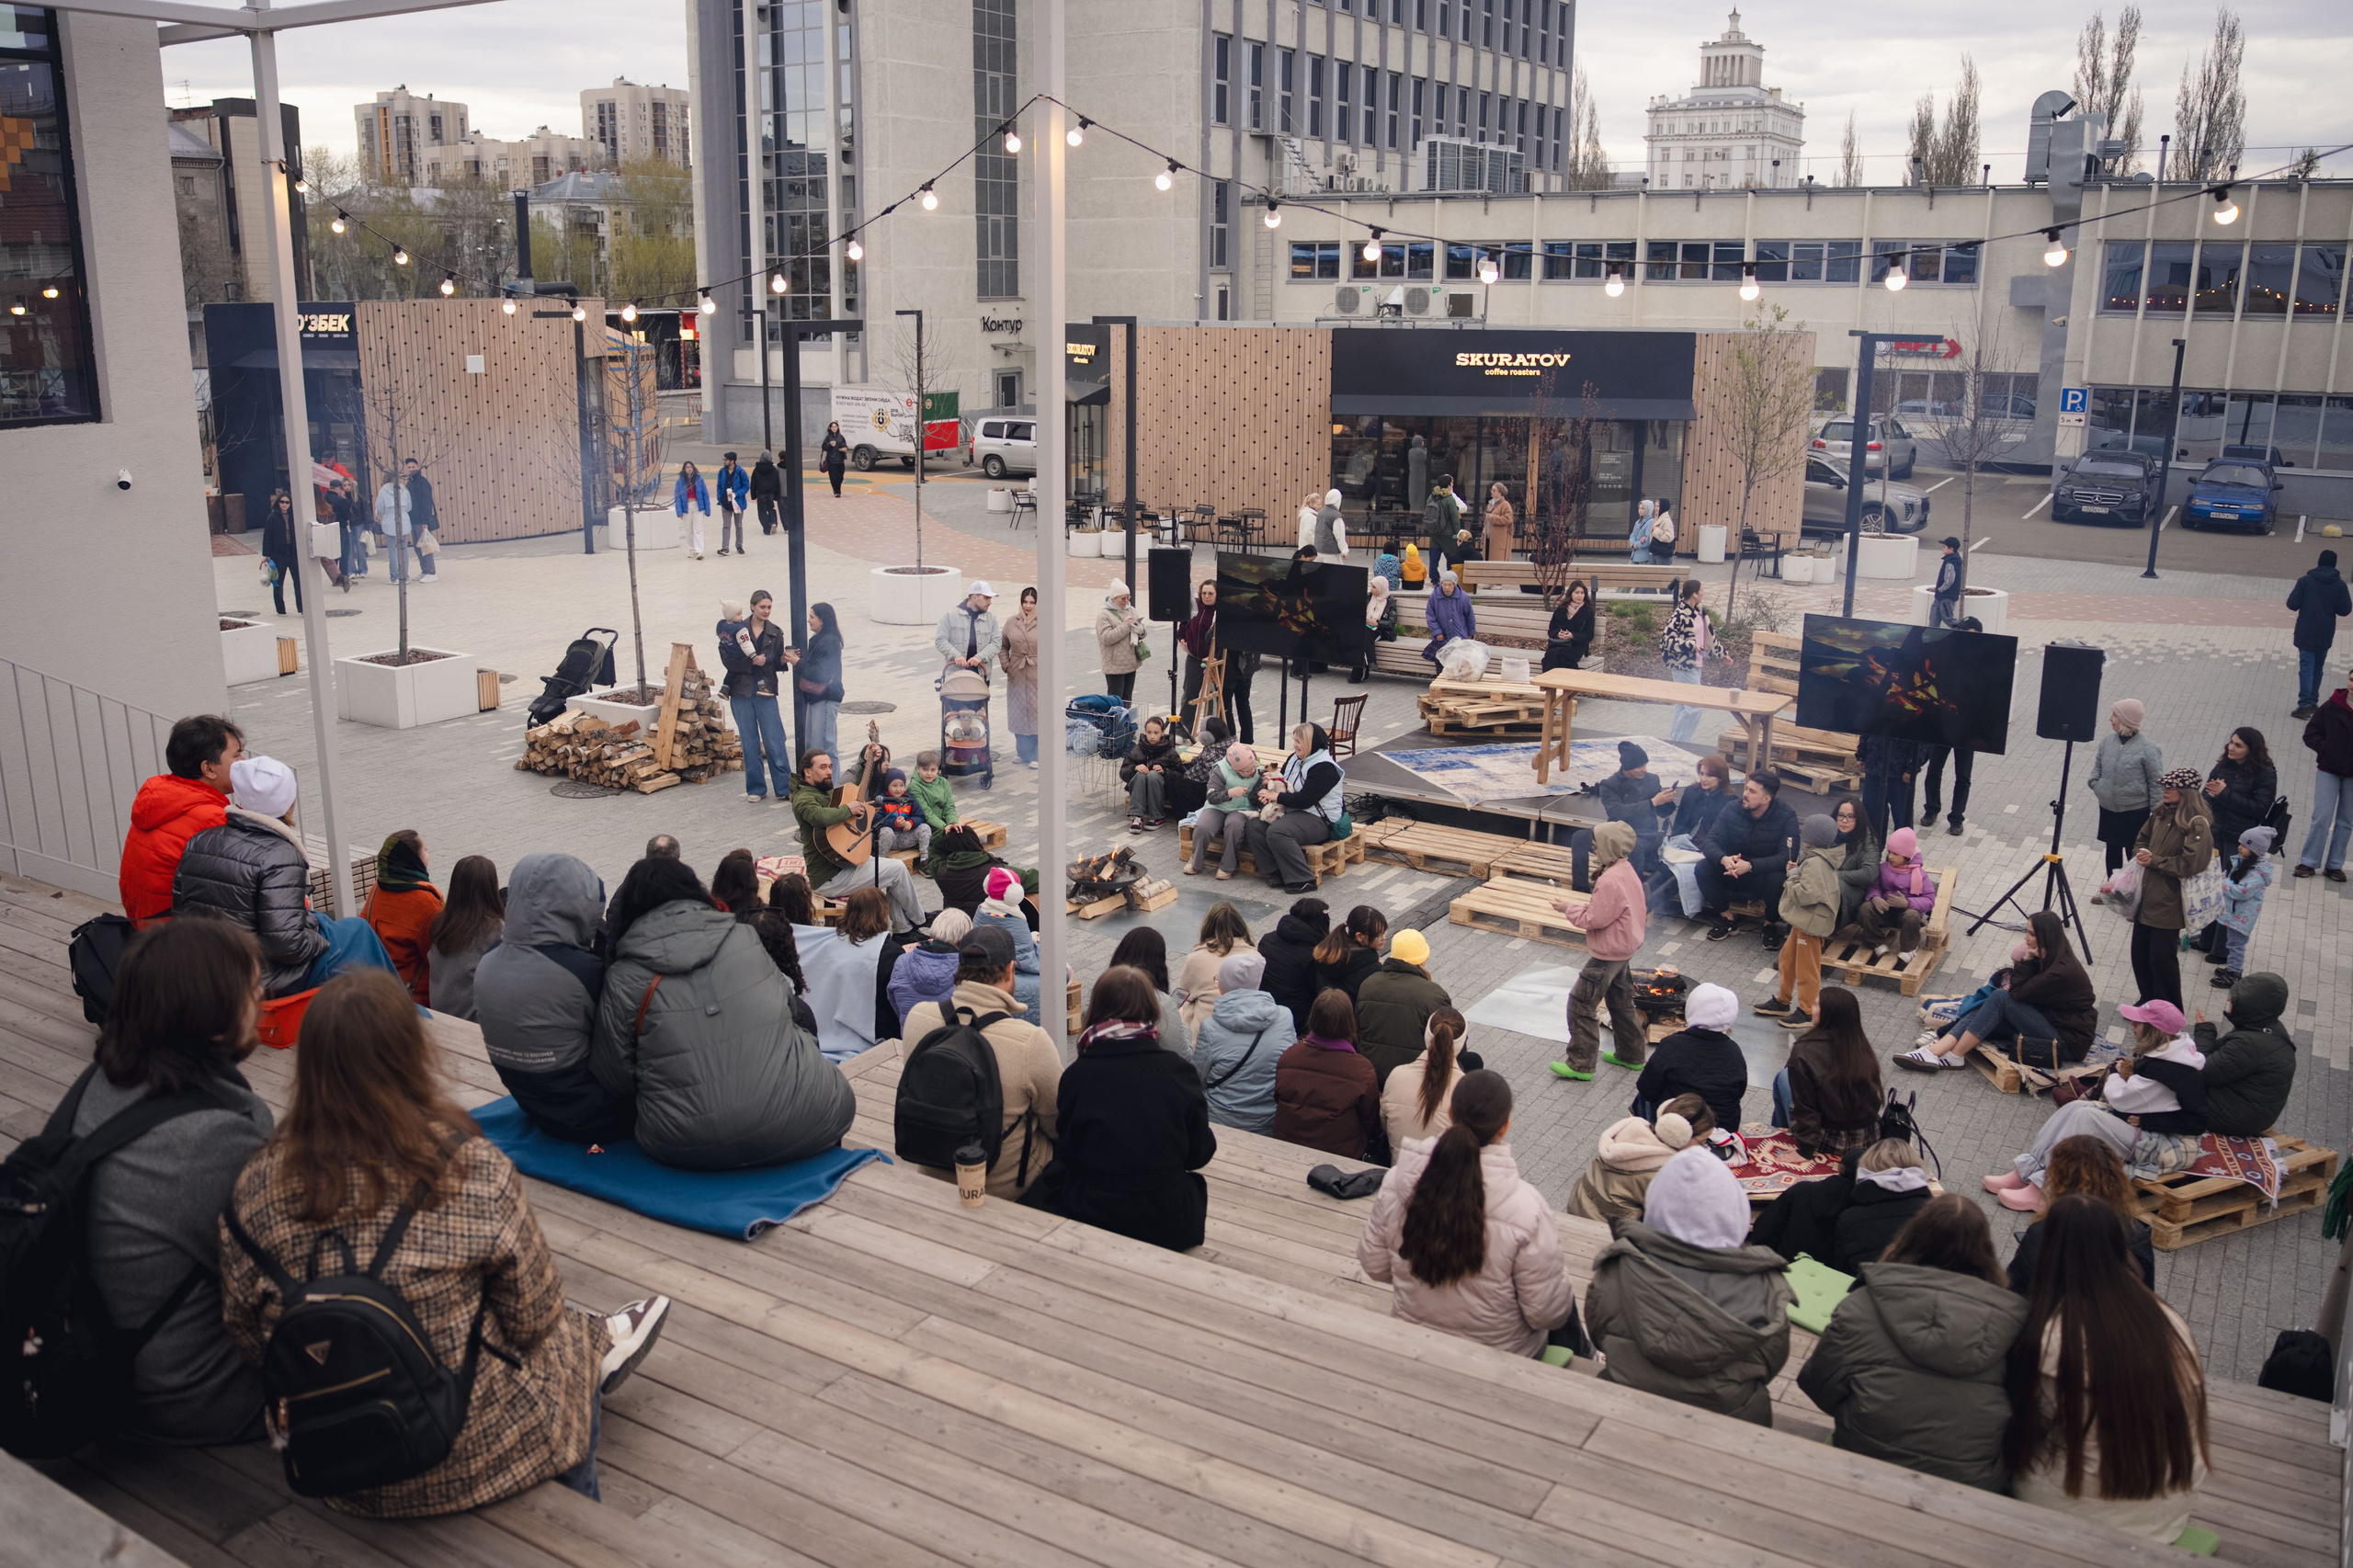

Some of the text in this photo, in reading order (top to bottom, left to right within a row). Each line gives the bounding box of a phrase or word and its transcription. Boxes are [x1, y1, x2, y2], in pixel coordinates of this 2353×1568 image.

[981, 316, 1022, 334] Контур
[1455, 352, 1572, 367] SKURATOV
[1484, 368, 1509, 376] coffee
[2066, 390, 2083, 411] P
